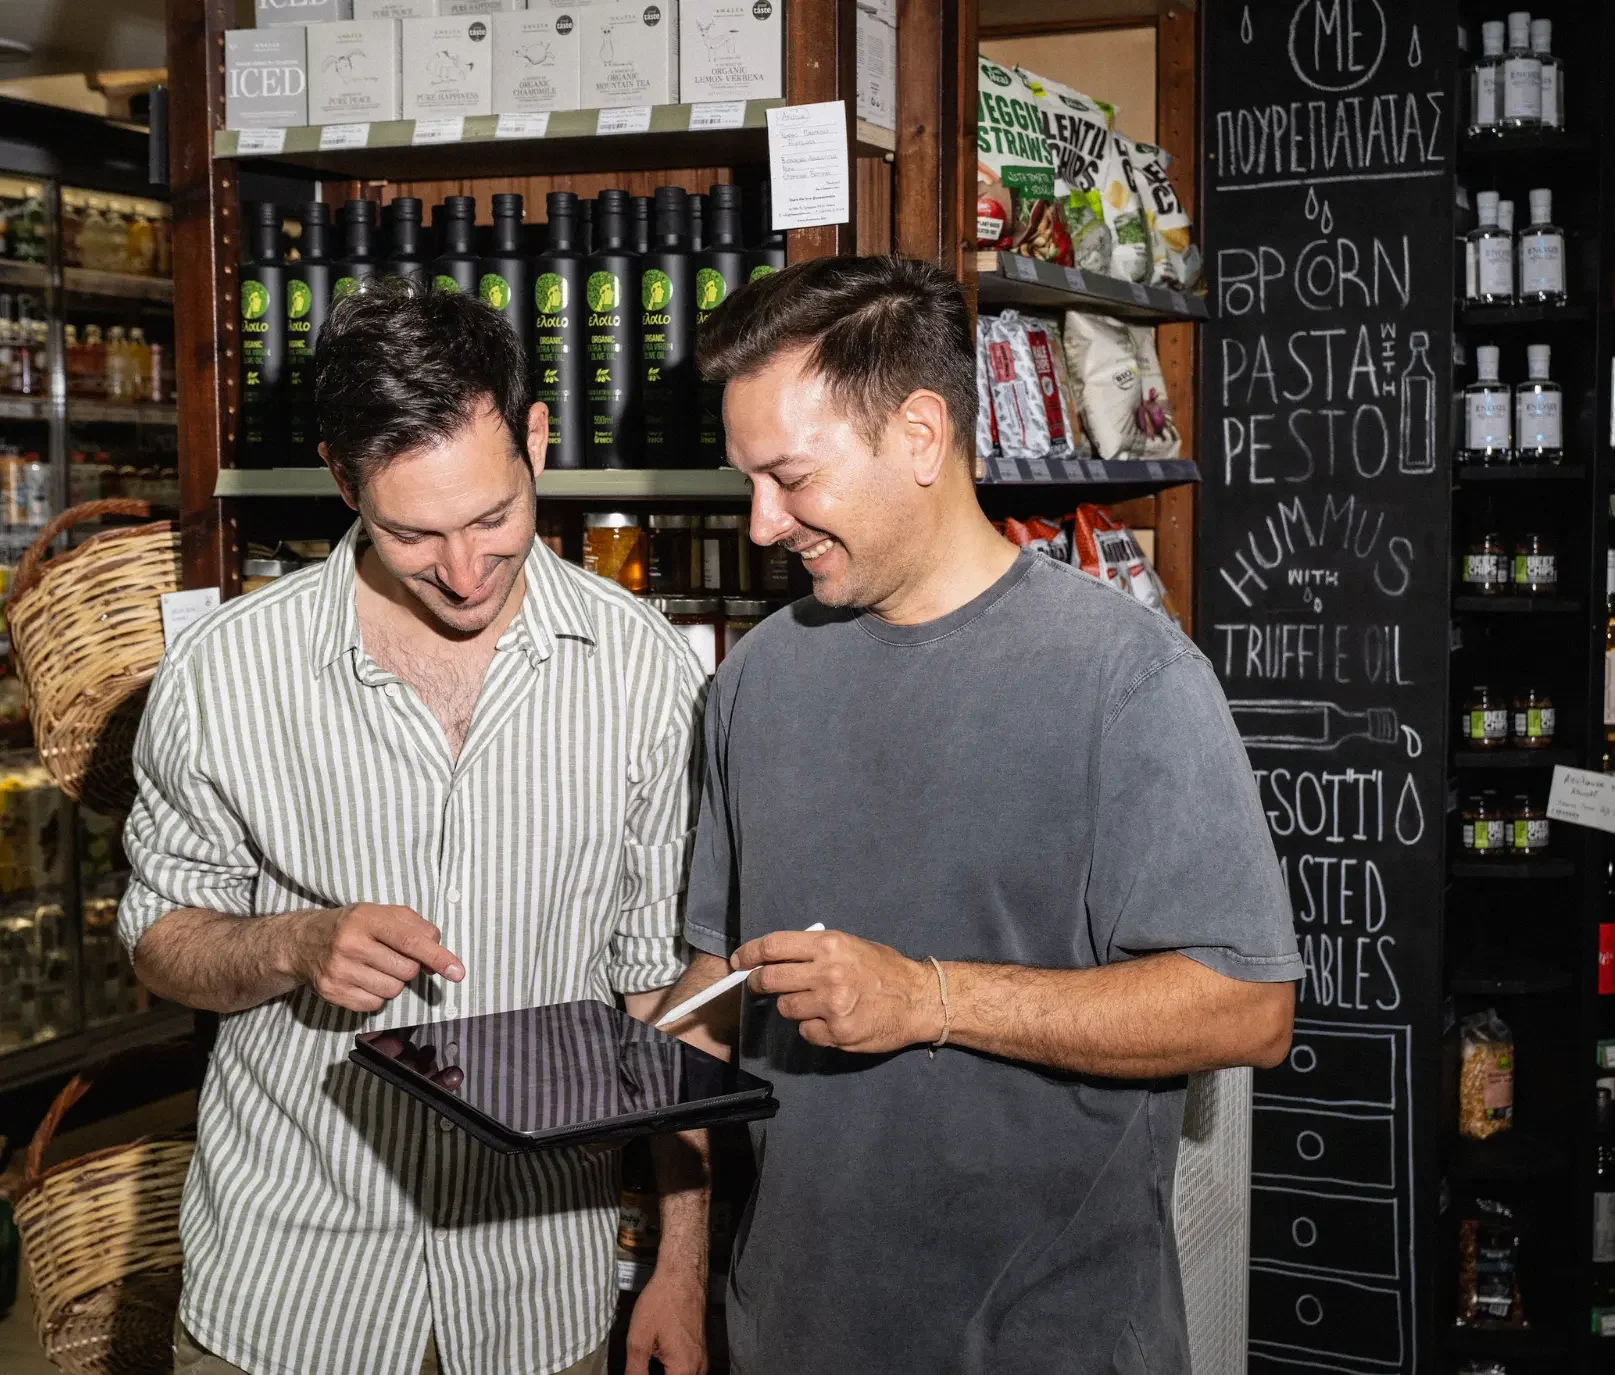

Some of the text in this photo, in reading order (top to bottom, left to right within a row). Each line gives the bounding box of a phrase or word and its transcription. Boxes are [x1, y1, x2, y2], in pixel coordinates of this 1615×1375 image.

[607, 72, 638, 82] ORGANIC
[712, 66, 747, 75] ORGANIC
[726, 74, 764, 82] VERBENA
[229, 67, 306, 98] ICED
[519, 80, 550, 89] ORGANIC
[596, 79, 651, 90] MOUNTAIN TEA
[438, 92, 479, 101] HAPPINESS
[512, 87, 557, 97] CHAMOMILE
[1041, 111, 1107, 161] LENTIL
[978, 125, 1054, 166] STRAWS
[1047, 142, 1099, 193] CHIPS
[539, 336, 563, 345] ORGANIC
[591, 335, 615, 344] ORGANIC
[1223, 324, 1379, 407] PASTA
[1381, 322, 1396, 396] WITH
[1115, 370, 1132, 382] BIO
[1223, 403, 1388, 486] PESTO
[1220, 493, 1414, 607] HUMMUS
[1288, 568, 1339, 586] WITH
[1365, 624, 1414, 685] OIL
